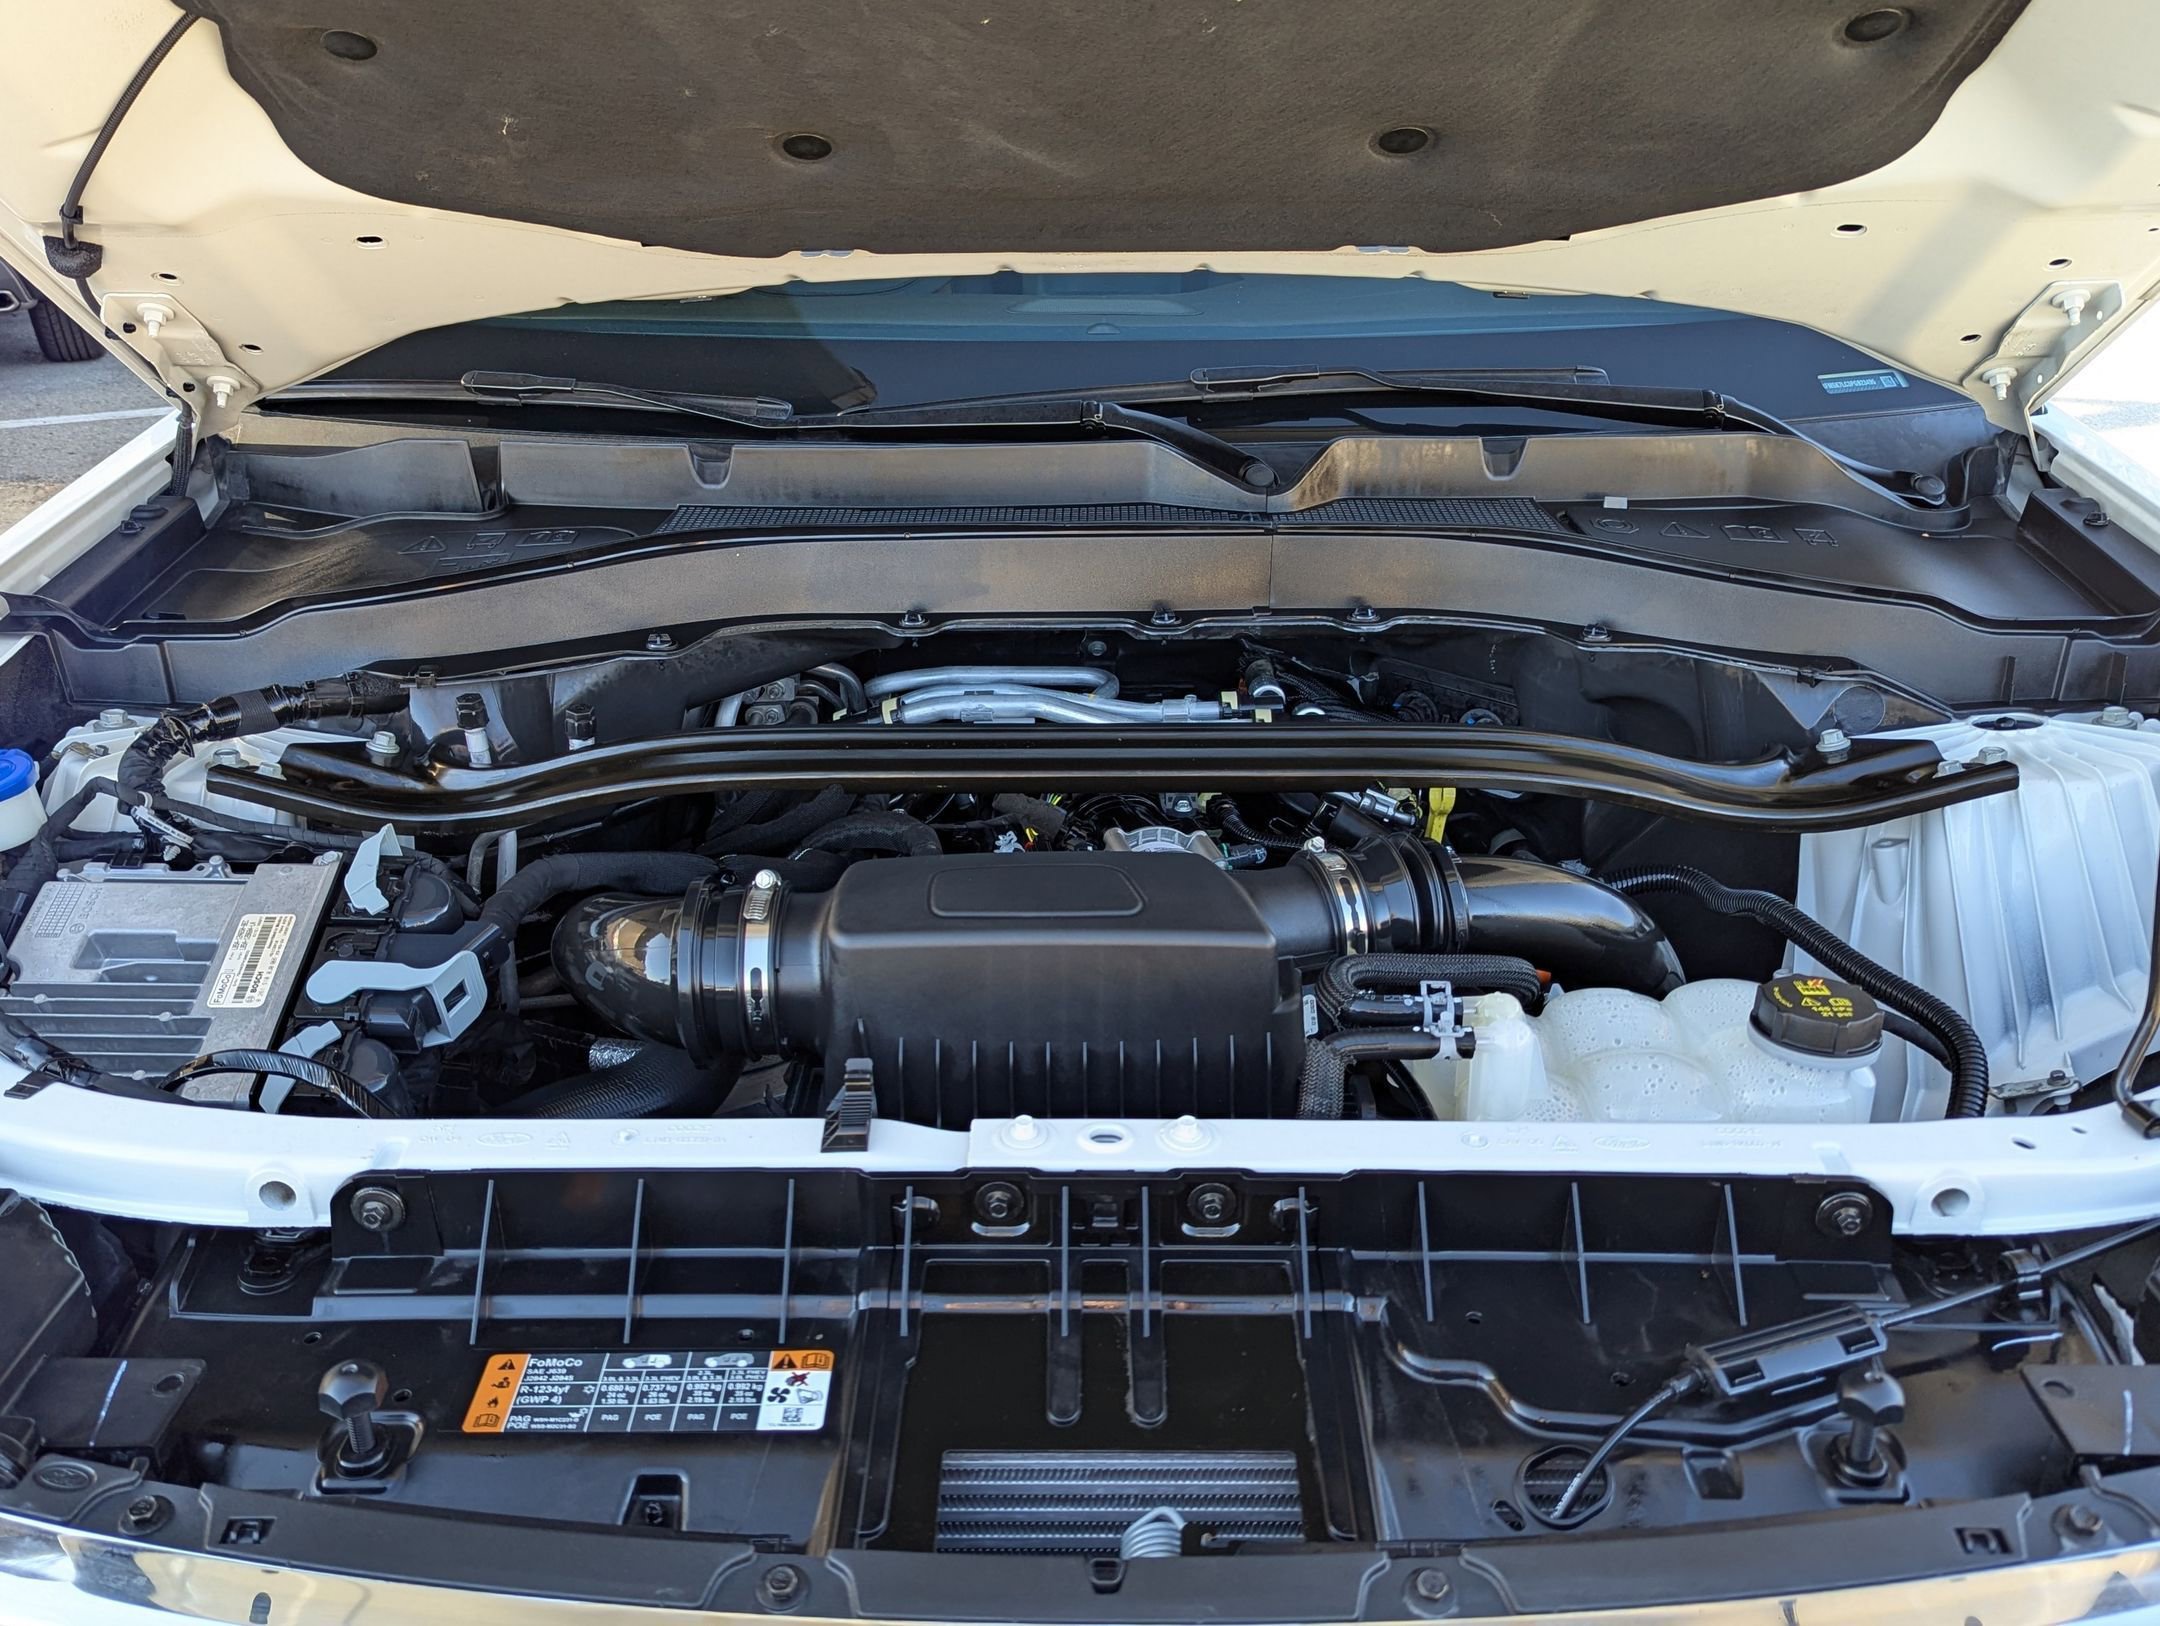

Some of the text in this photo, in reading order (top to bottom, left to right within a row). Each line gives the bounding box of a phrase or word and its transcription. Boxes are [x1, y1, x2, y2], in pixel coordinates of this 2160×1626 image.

[250, 971, 264, 993] BOSCH
[213, 974, 232, 1003] FoMoCo
[528, 1358, 583, 1367] FoMoCo
[520, 1385, 571, 1395] R-1234yf
[624, 1385, 636, 1393] kg
[665, 1385, 678, 1393] kg
[710, 1383, 722, 1392] kg
[751, 1383, 764, 1391] kg
[516, 1395, 562, 1405] (GWP 4)
